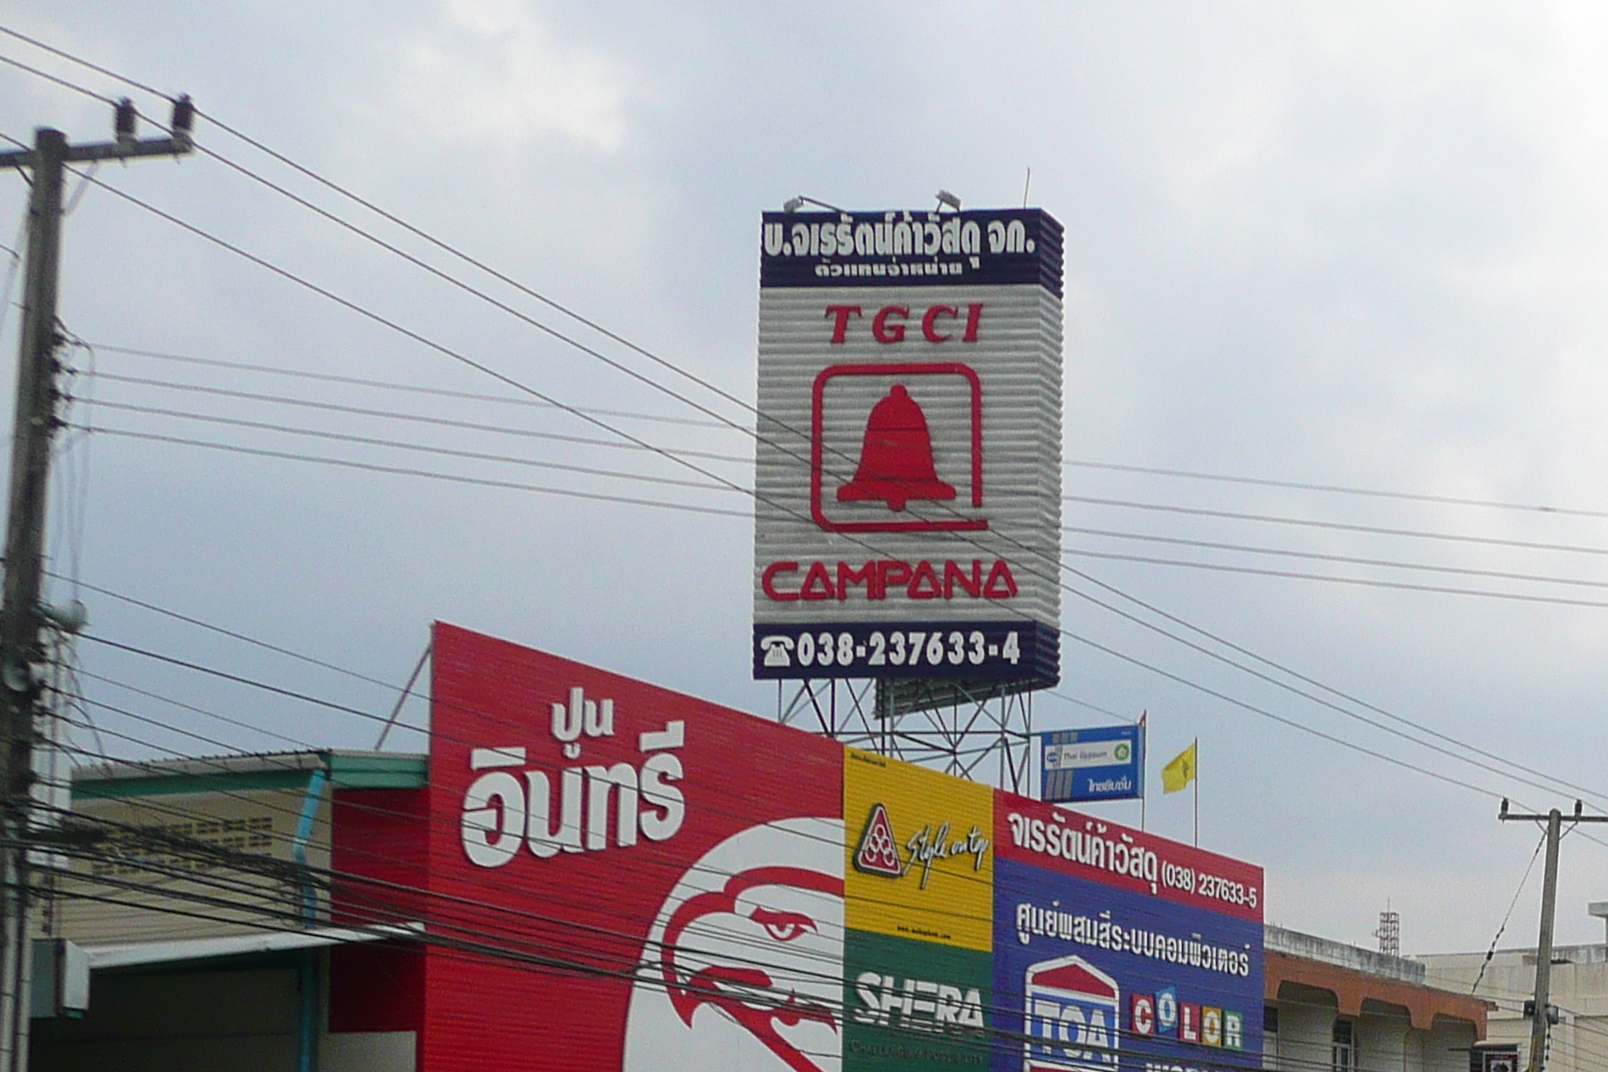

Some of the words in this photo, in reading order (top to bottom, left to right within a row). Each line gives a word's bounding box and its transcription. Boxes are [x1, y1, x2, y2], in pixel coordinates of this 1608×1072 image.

[761, 559, 1018, 601] CAMPANA
[797, 631, 1020, 666] 038-237633-4
[551, 686, 615, 760] ปูน
[461, 720, 686, 868] อินทรี
[1007, 811, 1158, 894] จเรรัตน์ค้าวัสดุ
[1160, 860, 1197, 894] (038)
[1198, 873, 1258, 909] 237633-5
[853, 971, 986, 1038] SHERA
[1033, 998, 1112, 1063] TOA
[1133, 992, 1243, 1048] COLOR
